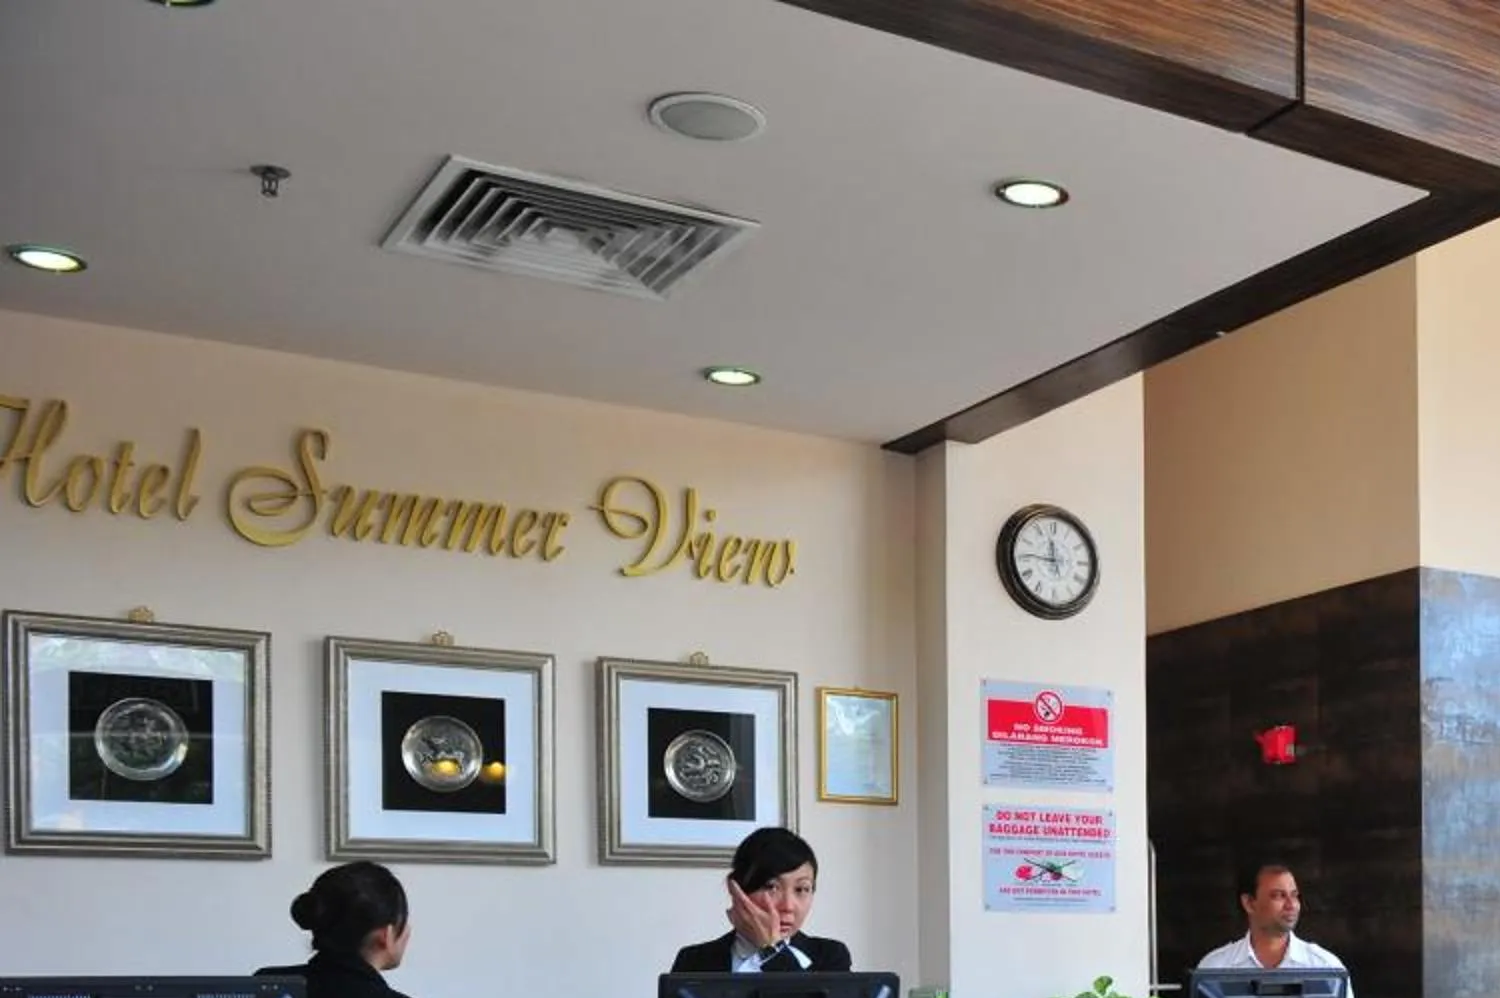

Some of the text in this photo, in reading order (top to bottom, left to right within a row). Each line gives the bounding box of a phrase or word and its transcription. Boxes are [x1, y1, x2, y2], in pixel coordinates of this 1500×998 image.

[0, 394, 798, 589] Hotel Summer View
[1013, 723, 1083, 735] NO SMOKING
[996, 810, 1103, 825] DO NOT LEAVE YOUR
[989, 823, 1039, 835] BAGGAGE
